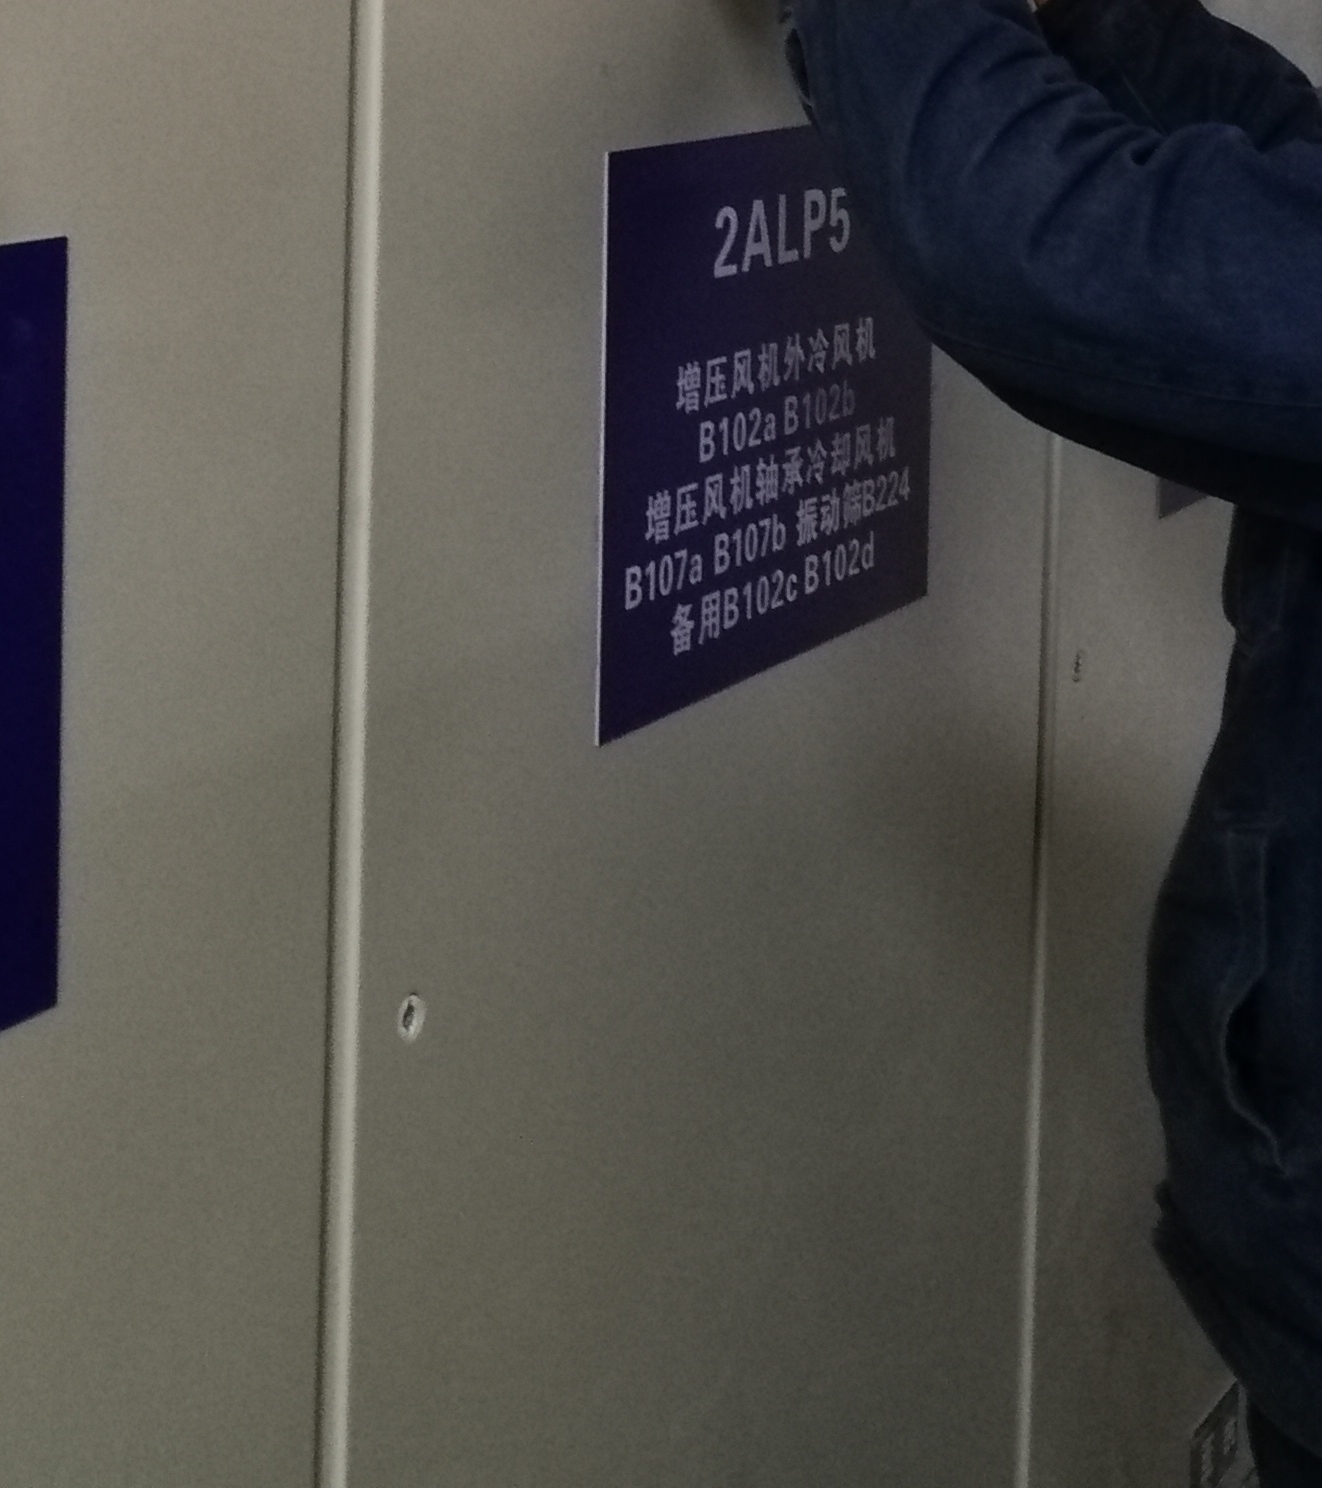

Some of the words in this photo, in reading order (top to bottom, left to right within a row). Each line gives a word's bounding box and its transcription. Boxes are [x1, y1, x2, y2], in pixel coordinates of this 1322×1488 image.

[713, 186, 852, 279] 2ALP5
[675, 316, 877, 415] 增压风机外冷风机
[698, 410, 776, 463] B102a
[784, 380, 856, 436] B102b
[644, 416, 896, 545] 增压风机轴承冷却风机
[624, 548, 703, 610] B107a
[714, 515, 787, 575] B107b
[670, 569, 798, 657] 备用B102c
[805, 531, 876, 596] B102d
